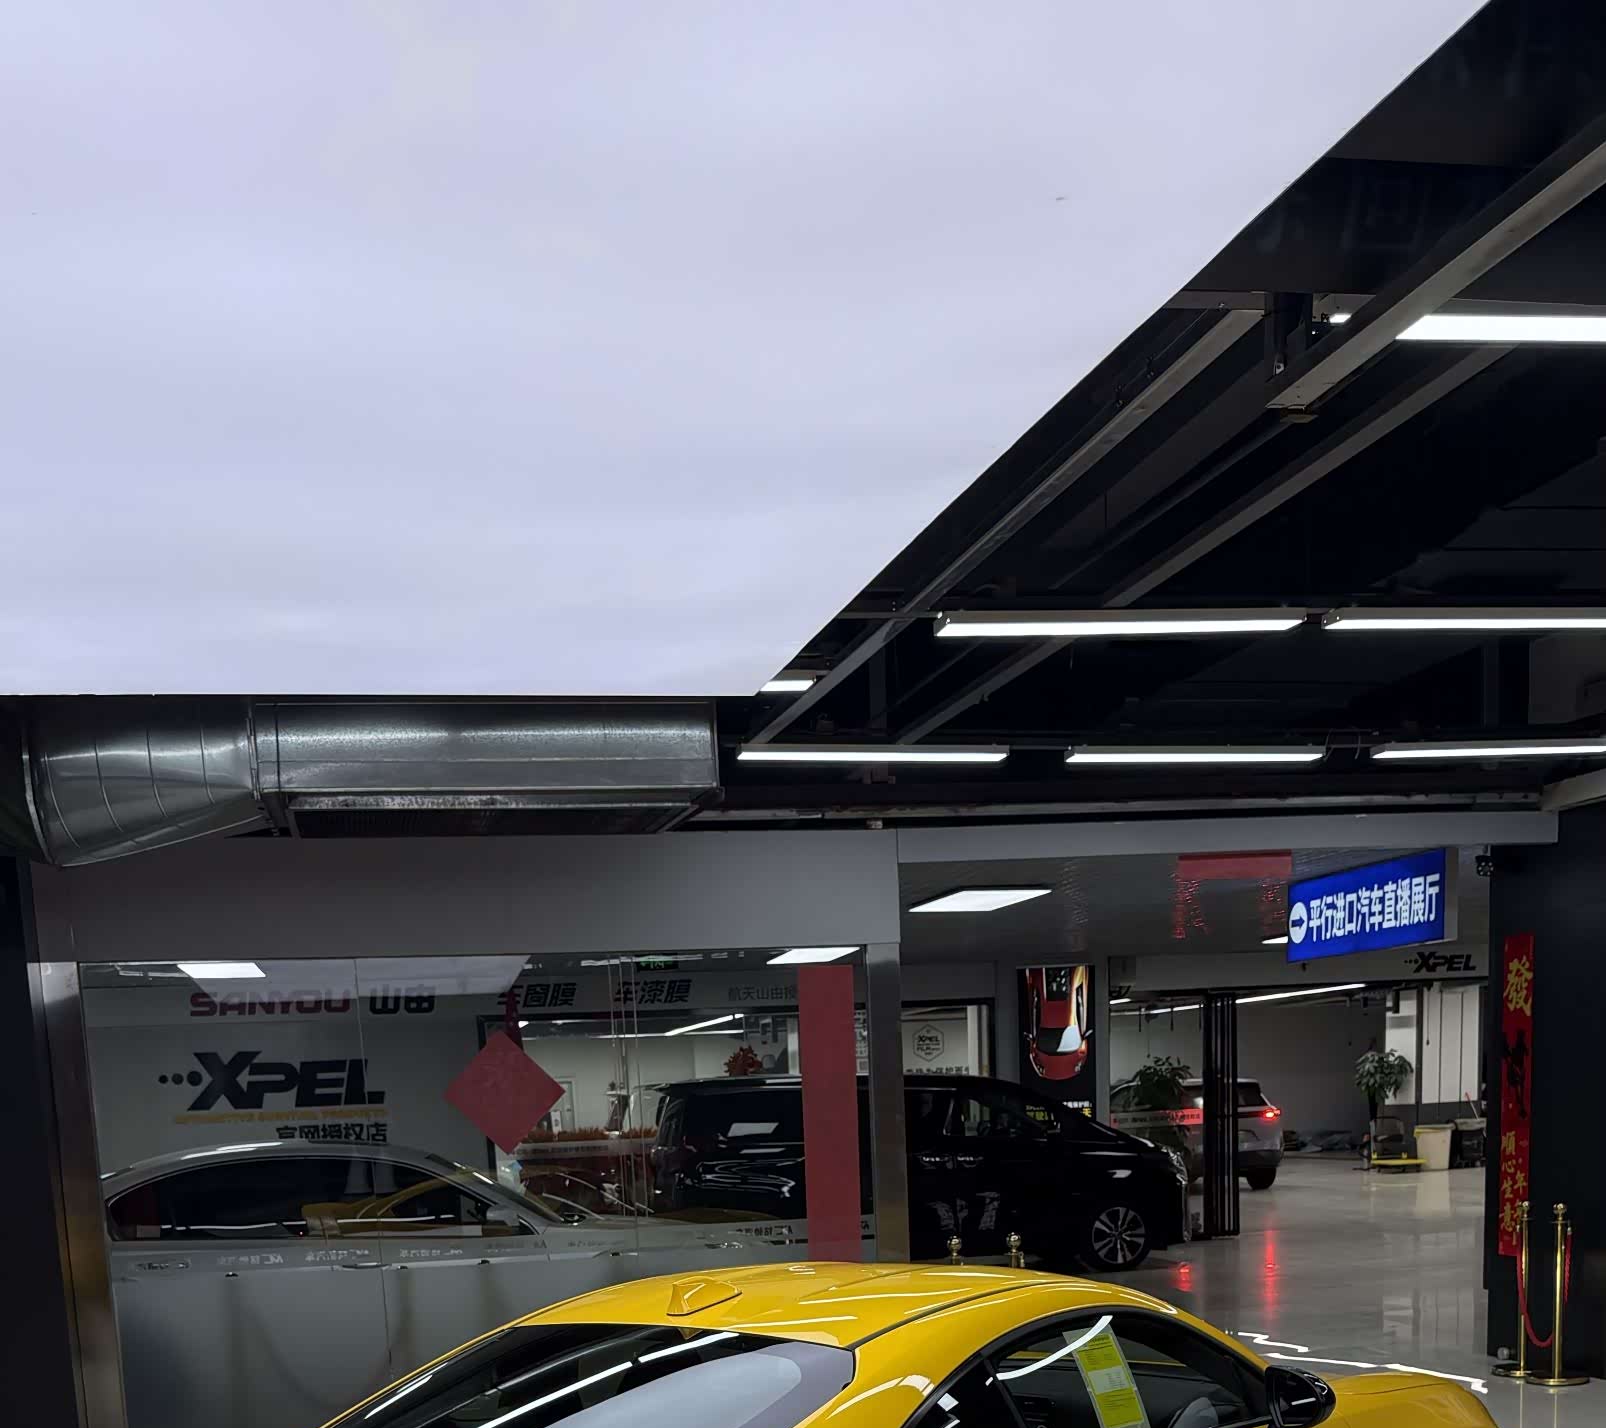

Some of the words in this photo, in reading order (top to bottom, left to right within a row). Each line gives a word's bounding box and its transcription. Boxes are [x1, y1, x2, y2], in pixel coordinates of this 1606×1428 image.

[1308, 873, 1441, 943] 平行进口汽车直播展厅
[1413, 952, 1477, 973] XPEL
[190, 988, 352, 1017] SANYOU
[615, 979, 693, 1005] 车漆膜
[186, 1051, 386, 1111] XPEL
